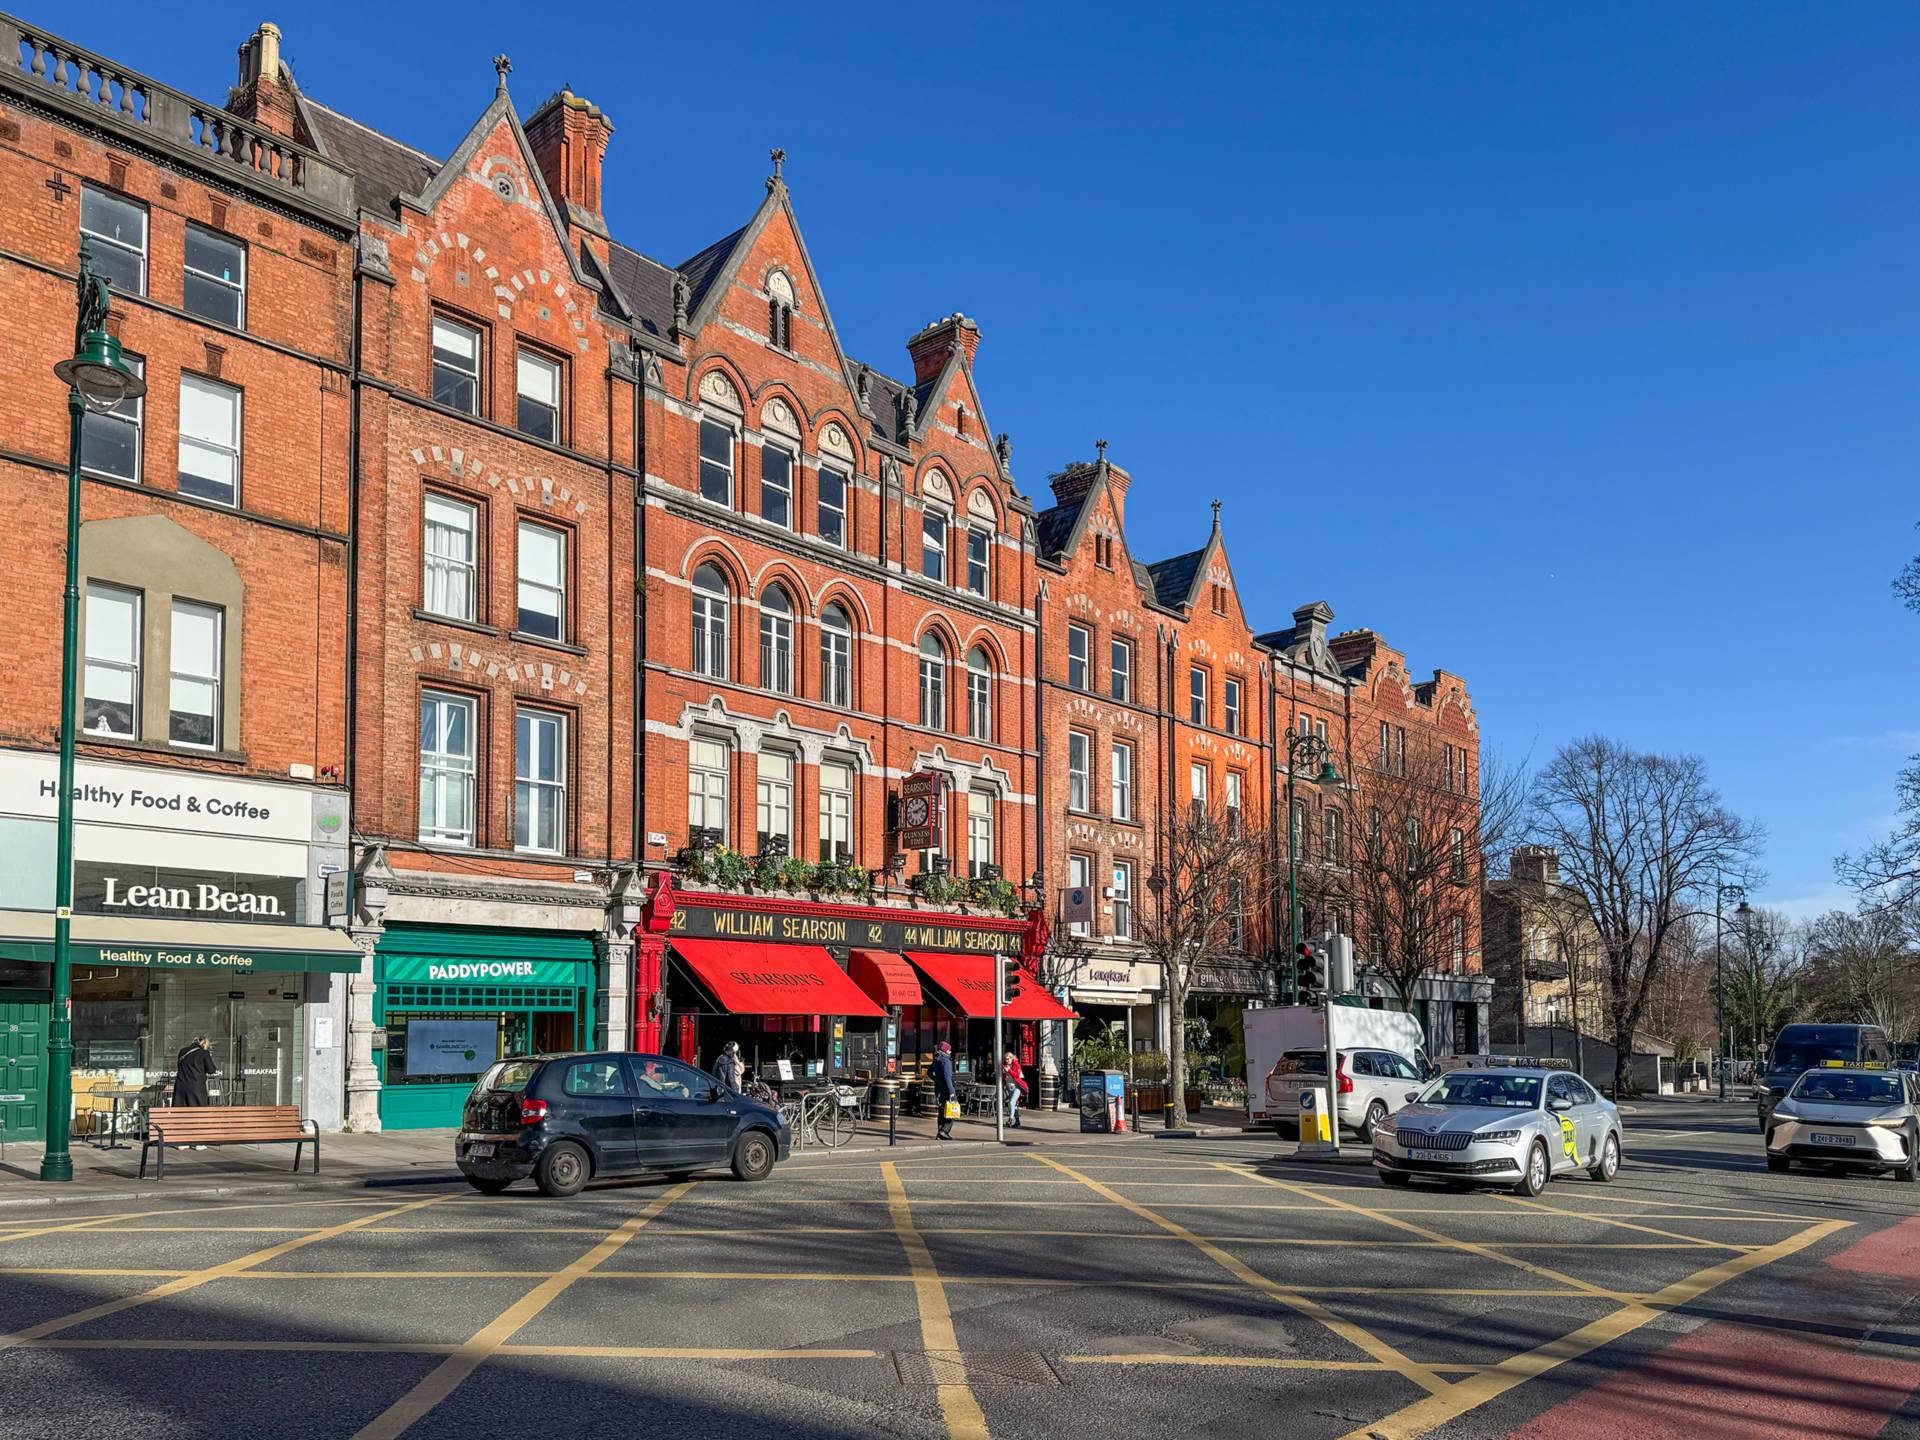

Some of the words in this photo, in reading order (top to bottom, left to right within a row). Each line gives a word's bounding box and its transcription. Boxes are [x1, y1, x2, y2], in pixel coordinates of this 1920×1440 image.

[39, 780, 124, 808] Halthy
[130, 790, 181, 811] Food
[186, 796, 201, 813] &
[206, 798, 270, 820] Coffee
[102, 877, 192, 910] Lean
[195, 884, 286, 917] Bean.
[670, 911, 686, 930] 42
[713, 911, 774, 937] WILLIAM
[782, 917, 846, 942] SEARSON
[867, 925, 883, 942] 42
[904, 928, 917, 943] 44
[919, 927, 961, 949] WILLIAM
[964, 931, 1008, 951] SEARSON
[100, 950, 152, 965] Healthy
[157, 951, 191, 964] Food
[196, 953, 206, 965] &
[210, 953, 253, 966] Coffee
[729, 971, 825, 987] SEARSON'S
[1200, 971, 1230, 987] ginkgo
[1518, 1058, 1539, 1066] TAXI
[1563, 1130, 1575, 1143] TAXI
